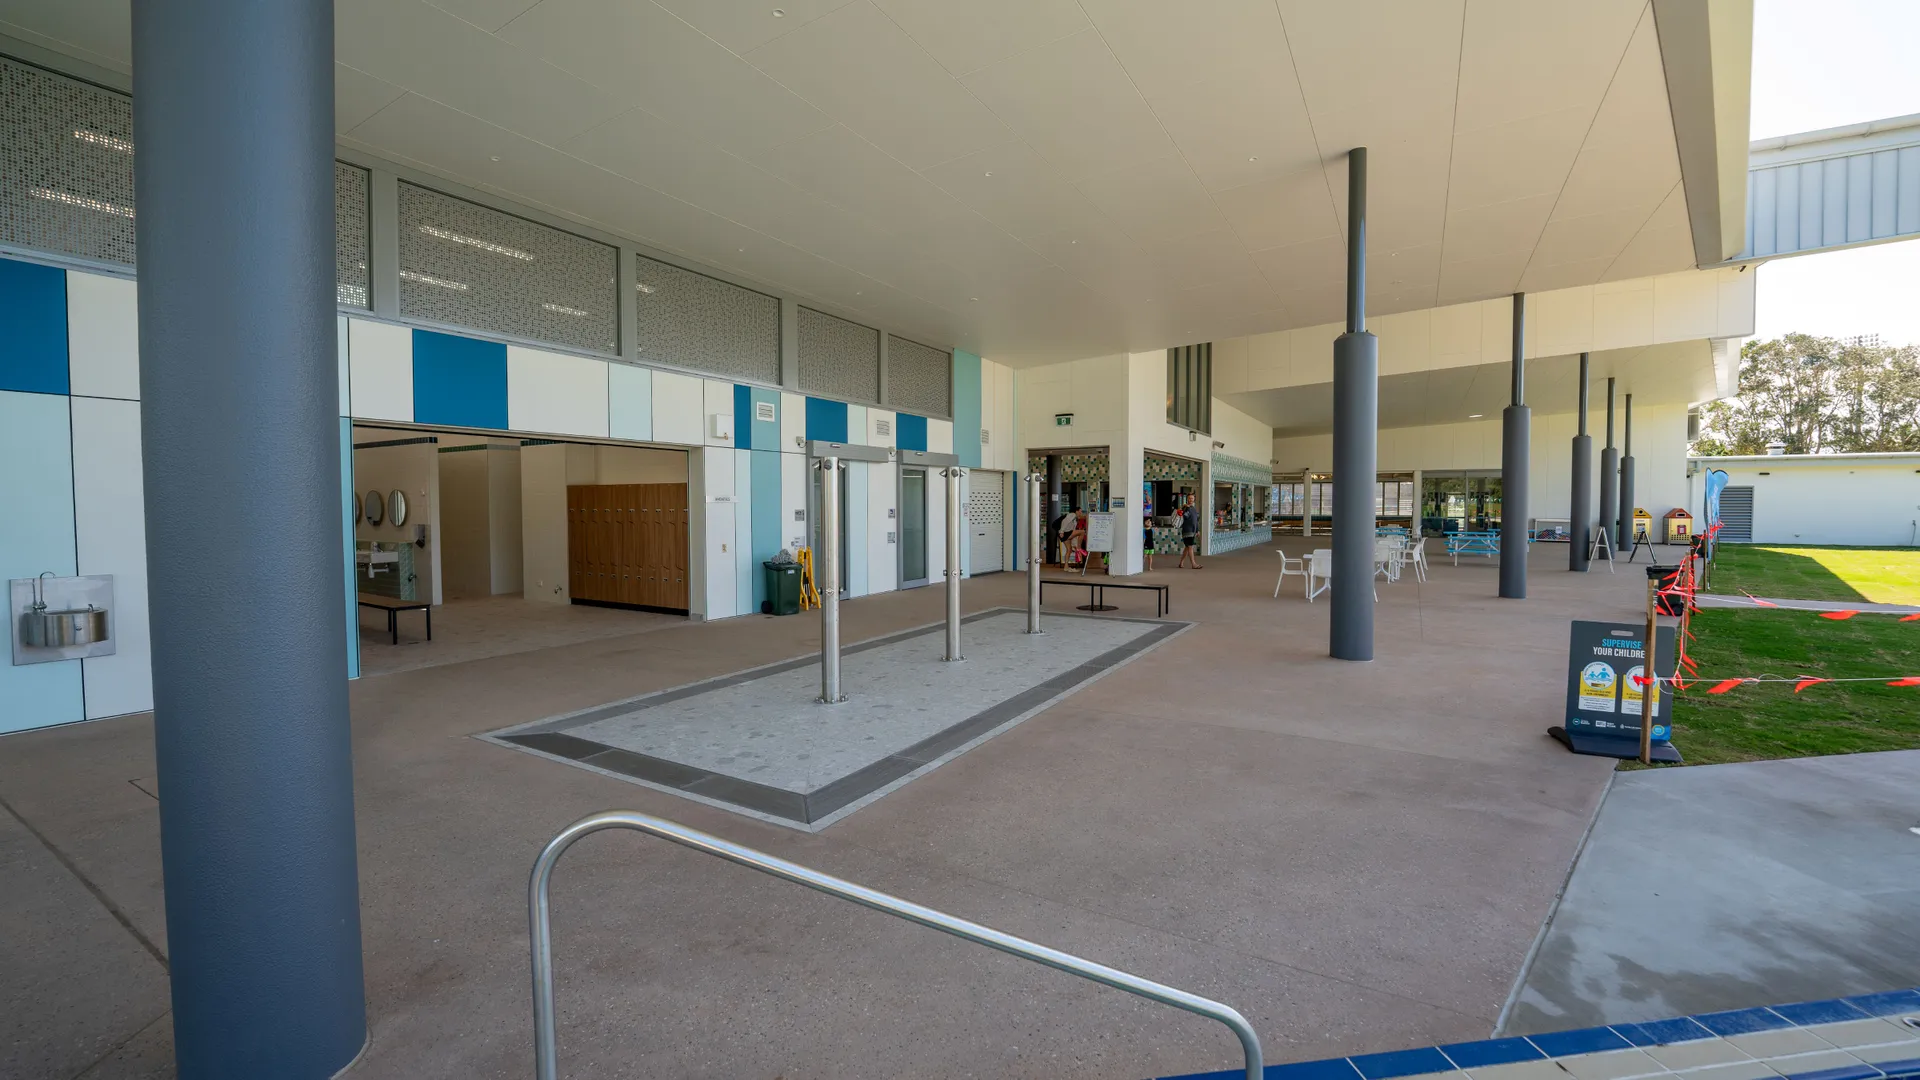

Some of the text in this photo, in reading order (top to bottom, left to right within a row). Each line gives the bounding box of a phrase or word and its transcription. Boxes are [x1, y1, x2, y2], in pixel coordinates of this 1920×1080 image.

[1602, 638, 1642, 649] SUPERVISE
[1593, 646, 1645, 659] YOUR CHILDRE
